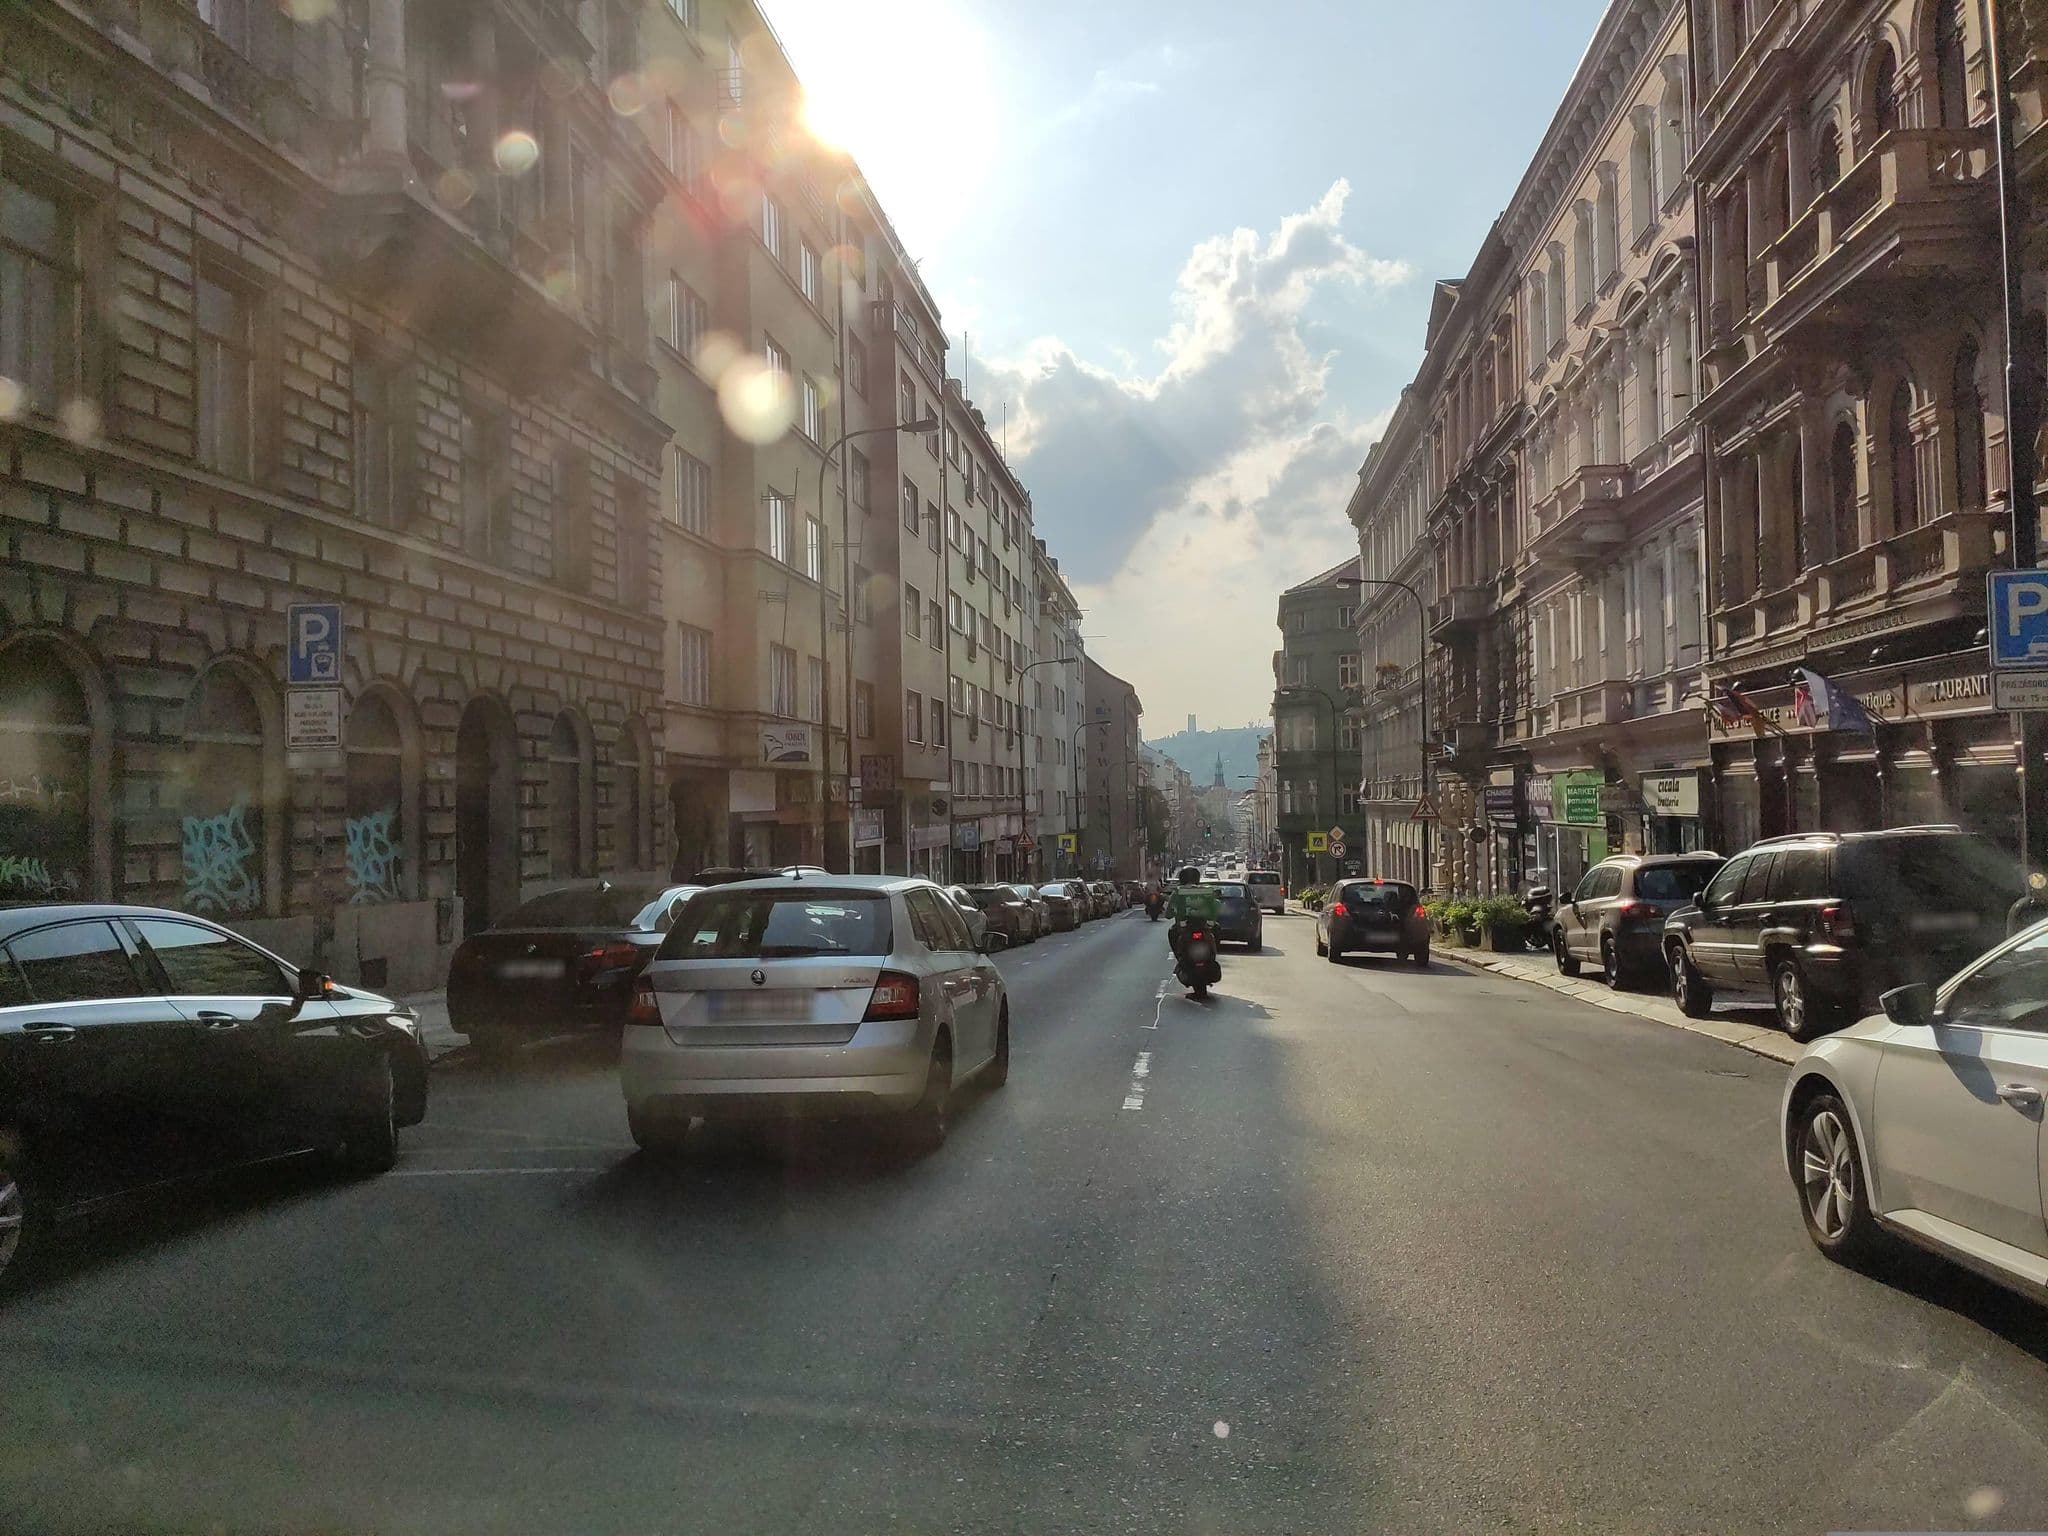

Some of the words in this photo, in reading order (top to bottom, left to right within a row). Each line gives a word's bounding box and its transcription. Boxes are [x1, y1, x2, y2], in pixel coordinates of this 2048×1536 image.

[2007, 582, 2048, 636] P
[299, 613, 330, 659] P
[1485, 788, 1513, 797] CHANGE
[1524, 779, 1552, 801] CHANGE
[1567, 787, 1596, 795] MARKET
